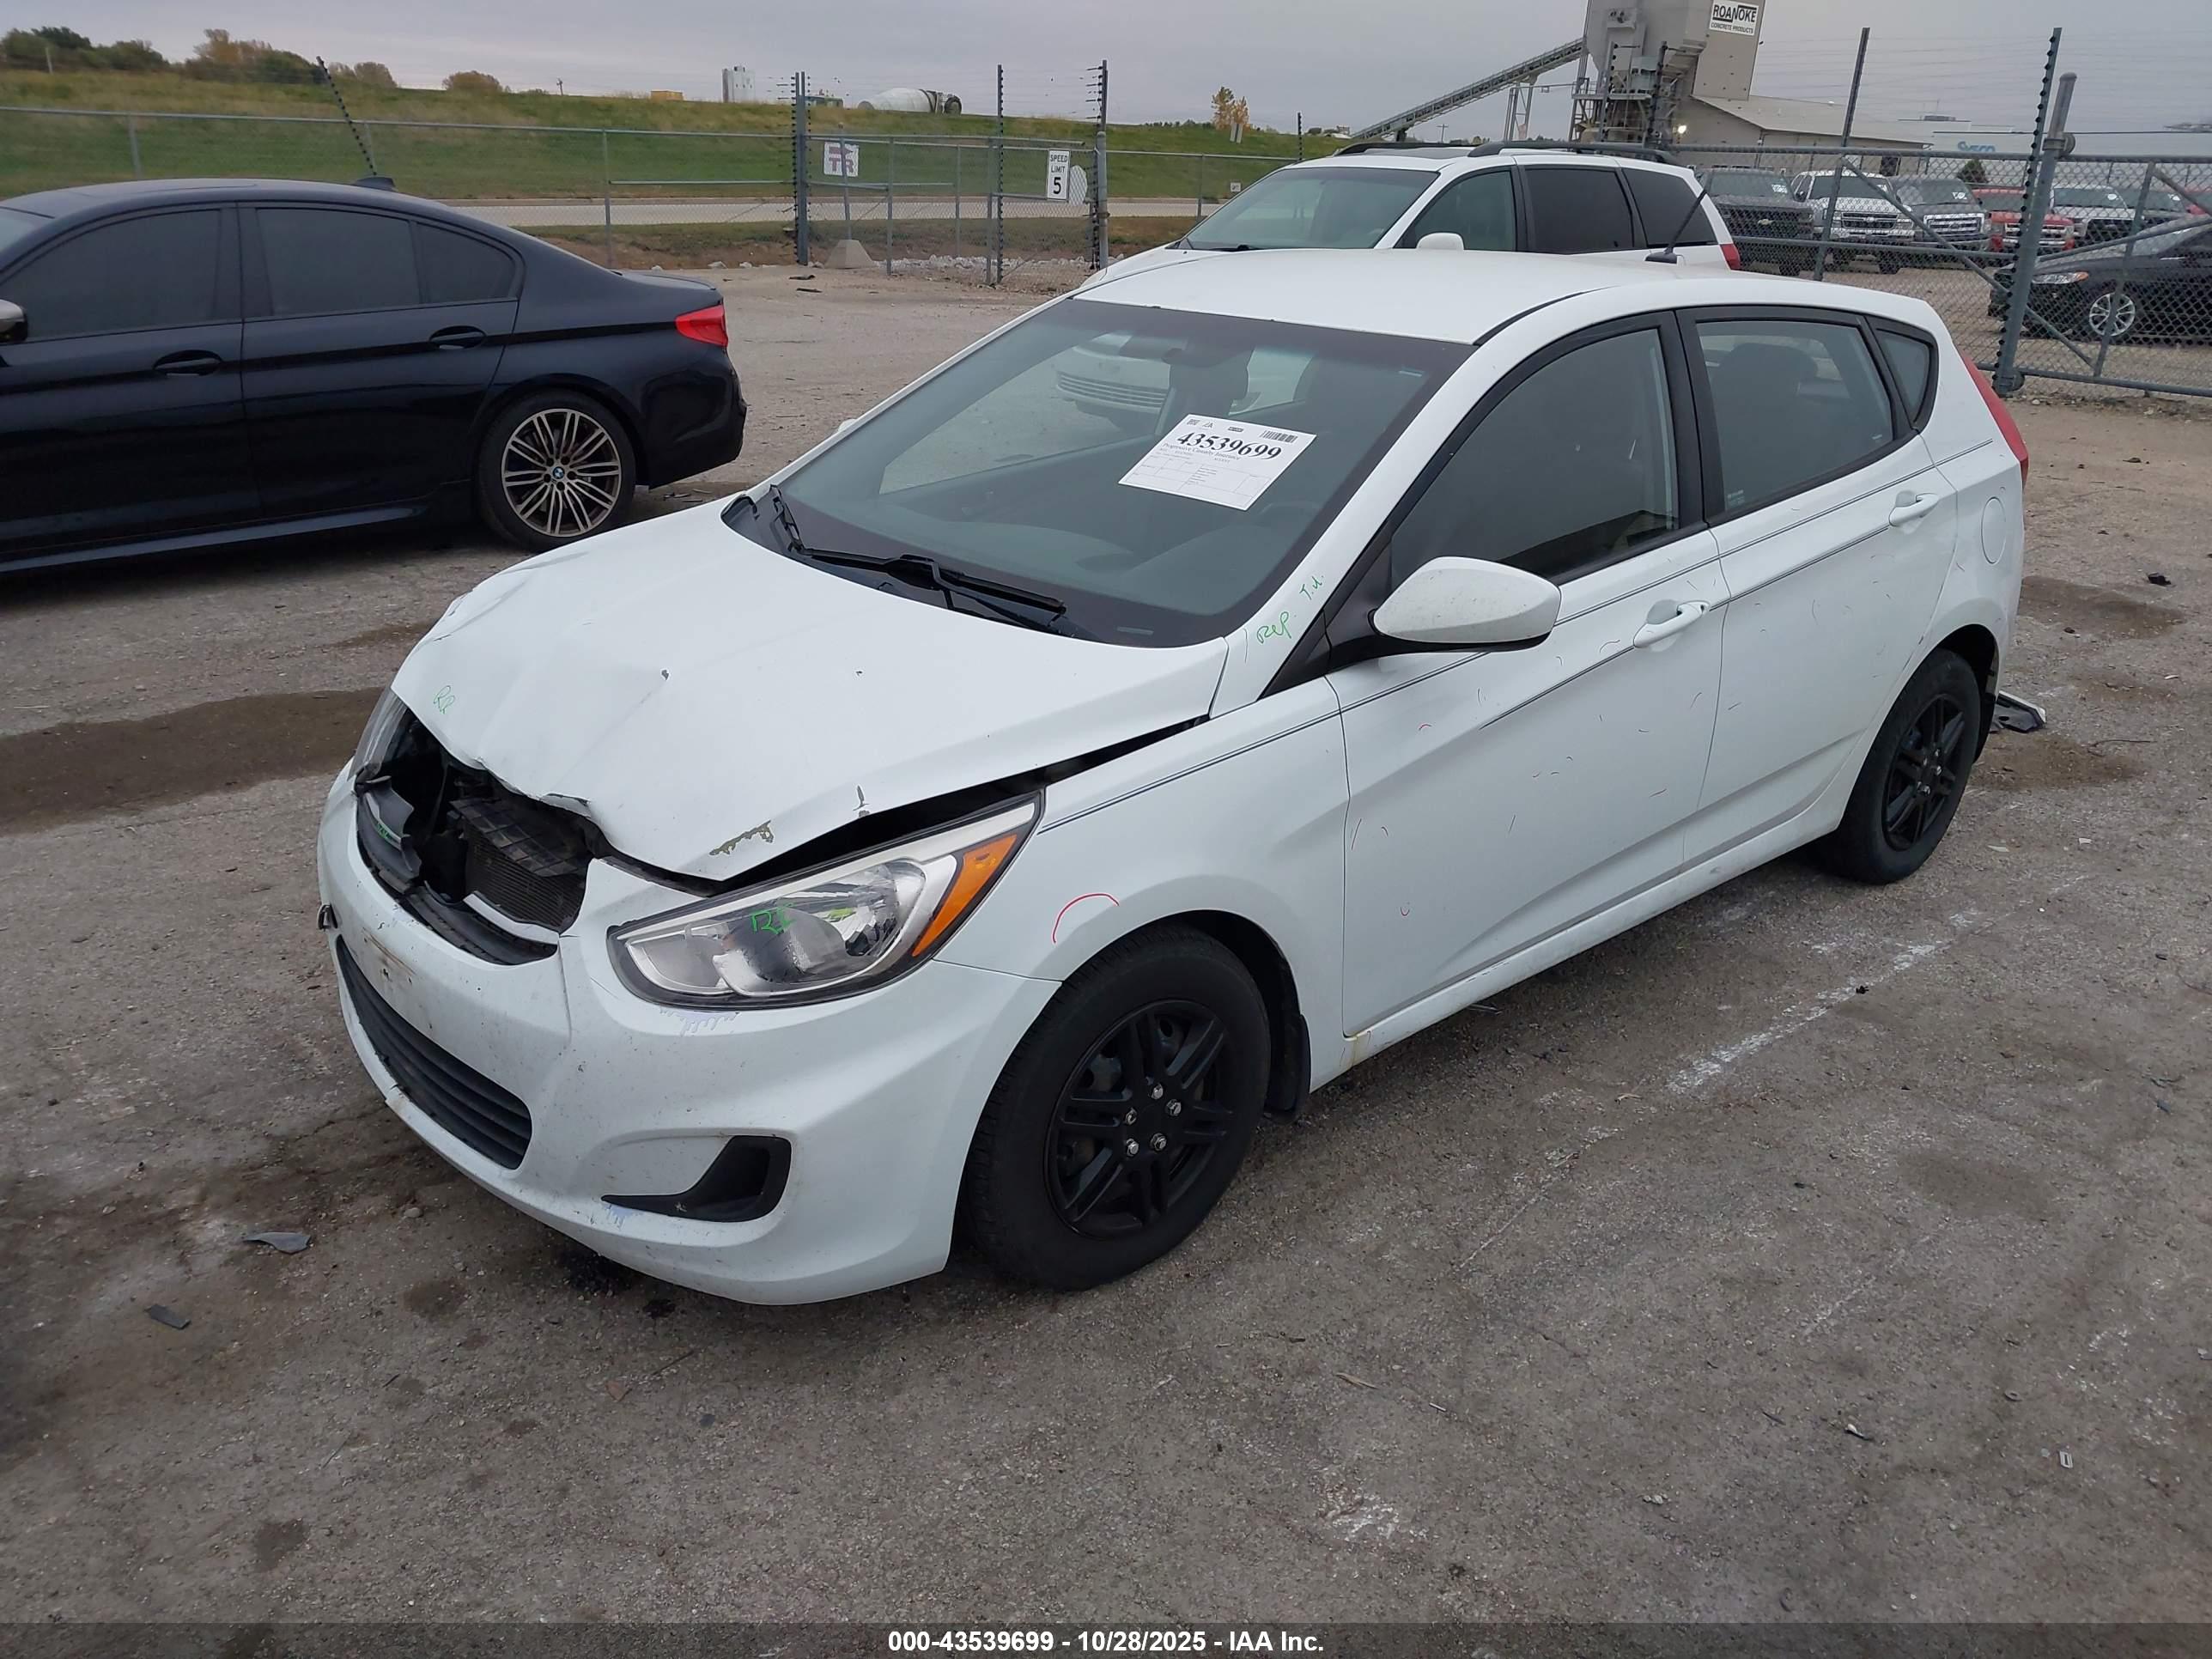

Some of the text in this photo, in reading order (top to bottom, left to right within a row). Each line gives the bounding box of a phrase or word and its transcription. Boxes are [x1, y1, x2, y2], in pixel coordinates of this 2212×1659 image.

[1712, 4, 1757, 23] ROANOKE
[1732, 25, 1753, 34] PRODUCTS
[1050, 155, 1067, 163] SPEED
[1053, 176, 1062, 195] 5
[1177, 432, 1282, 460] 43539699
